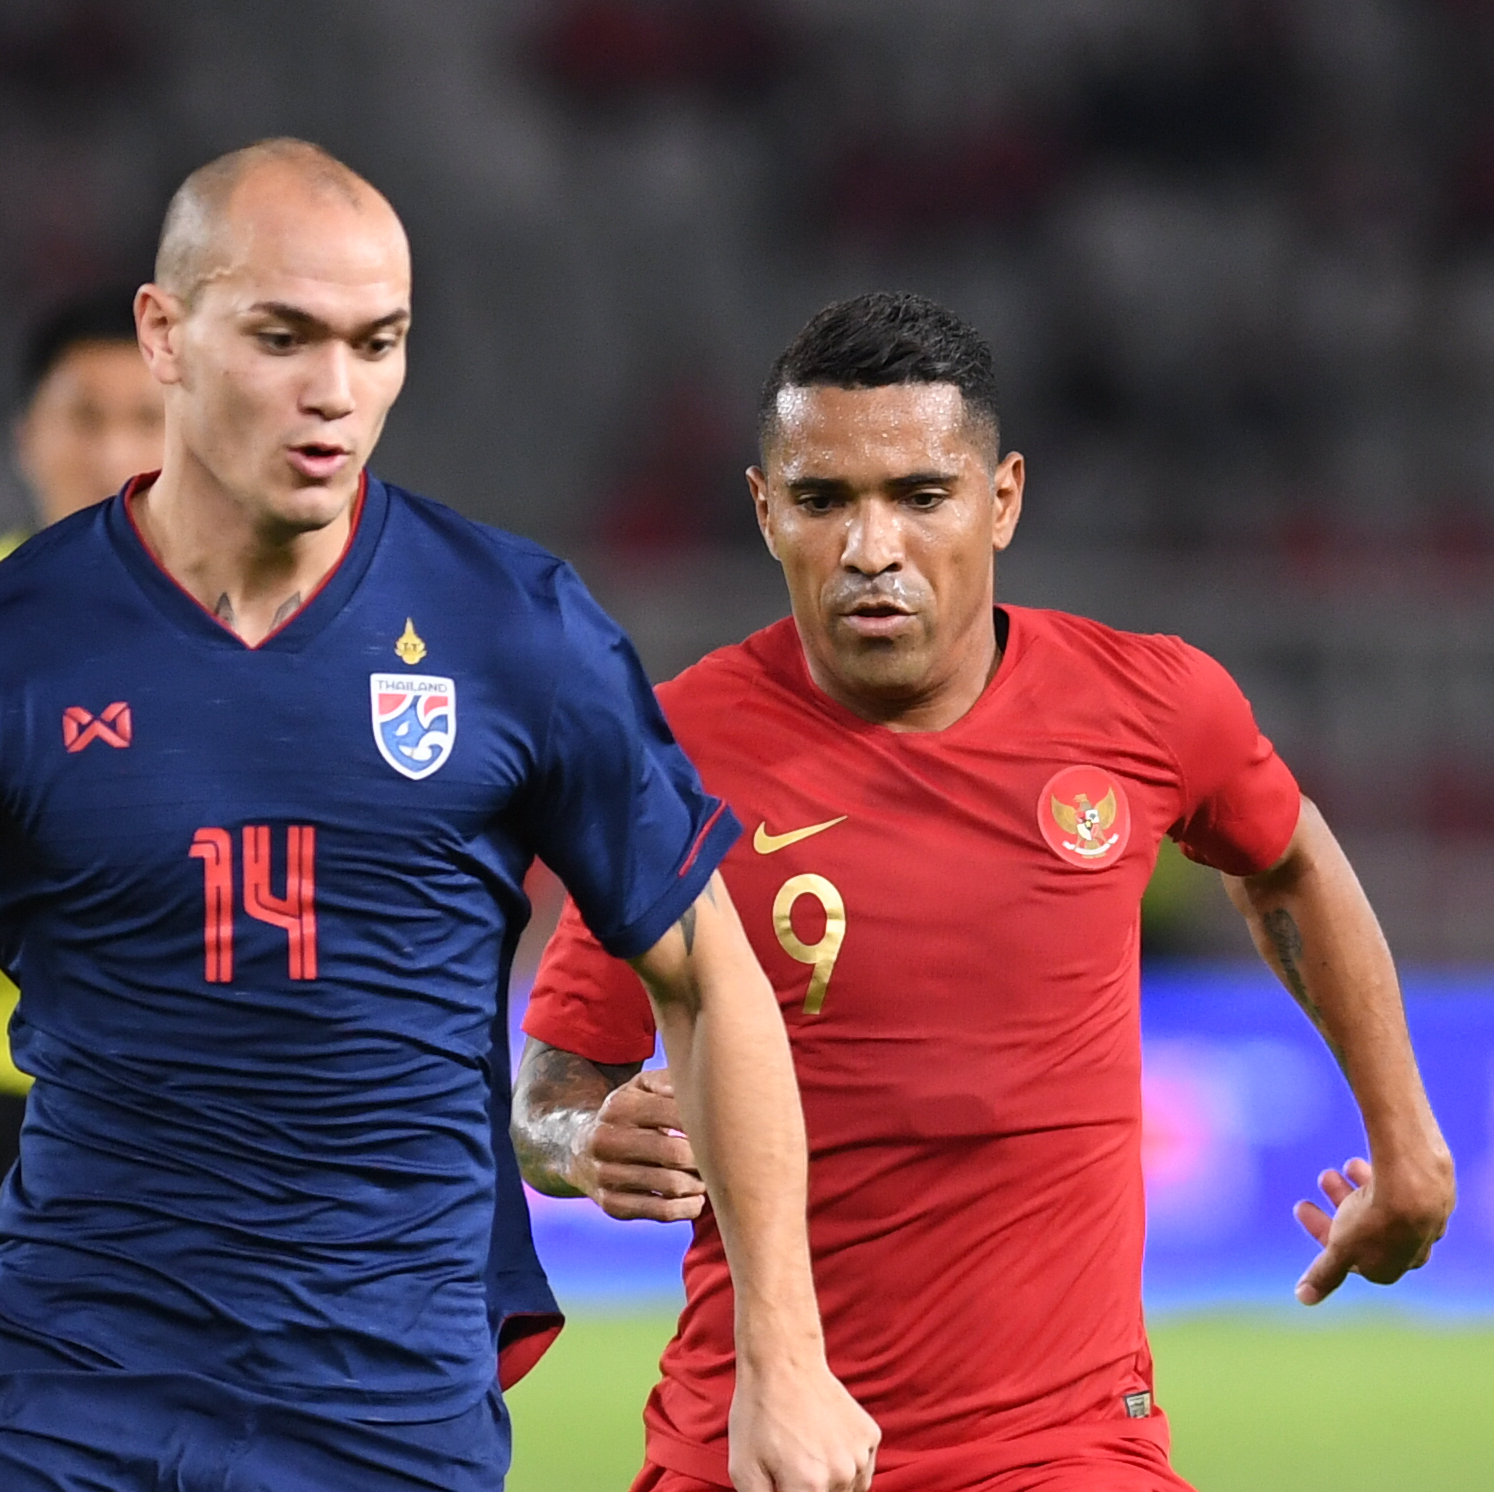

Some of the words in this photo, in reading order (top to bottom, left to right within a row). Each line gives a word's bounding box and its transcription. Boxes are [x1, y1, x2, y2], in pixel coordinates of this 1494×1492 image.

[377, 679, 448, 693] THAILAND
[188, 825, 318, 983] 14
[772, 873, 846, 1015] 9
